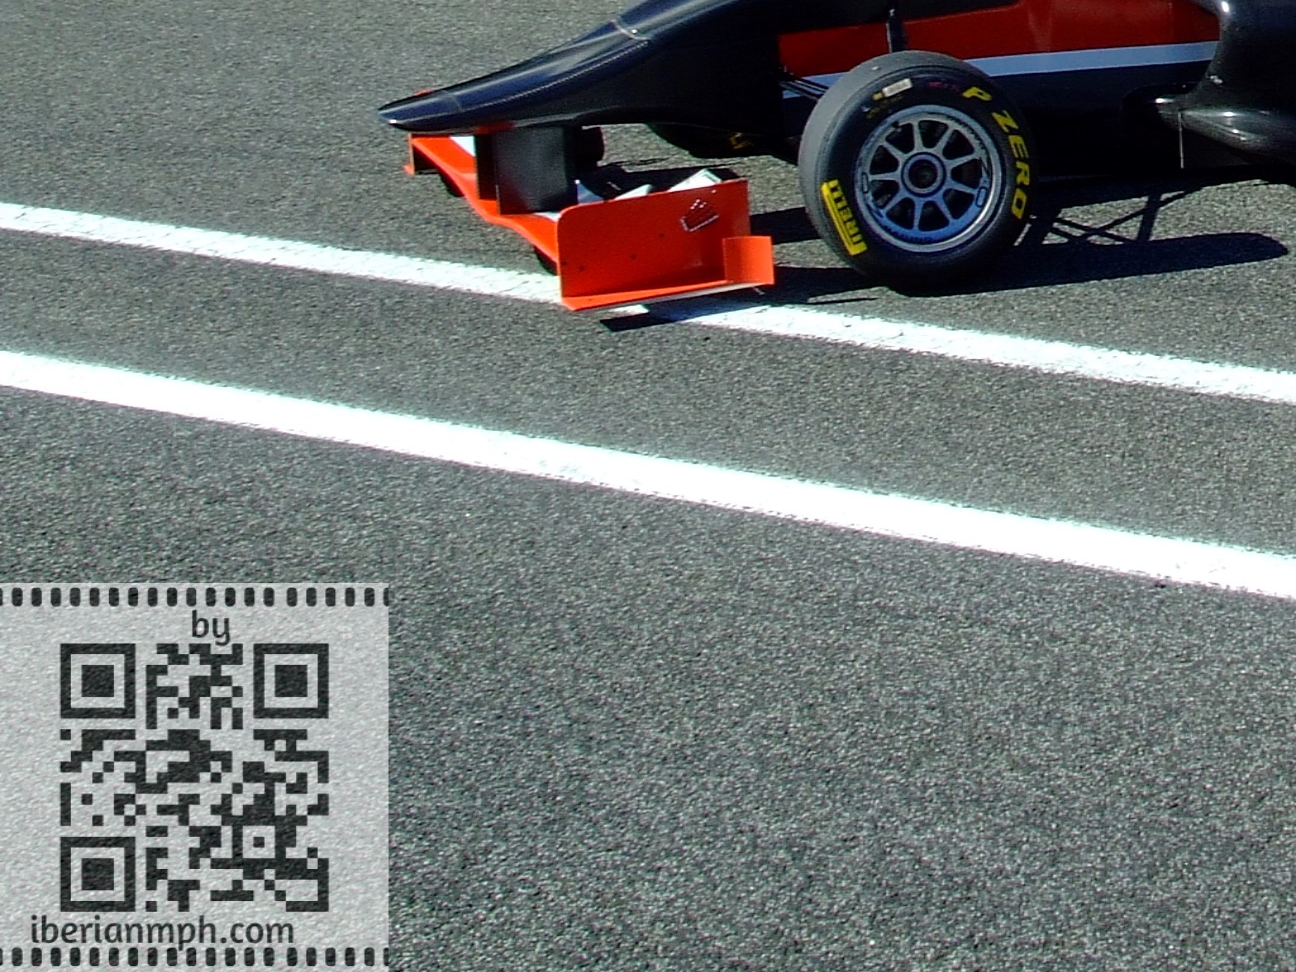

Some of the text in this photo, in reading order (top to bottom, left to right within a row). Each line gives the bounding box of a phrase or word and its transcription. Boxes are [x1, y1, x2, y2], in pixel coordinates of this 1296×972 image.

[961, 86, 993, 102] P
[992, 110, 1031, 220] ZERO
[821, 179, 868, 256] PIRELLI
